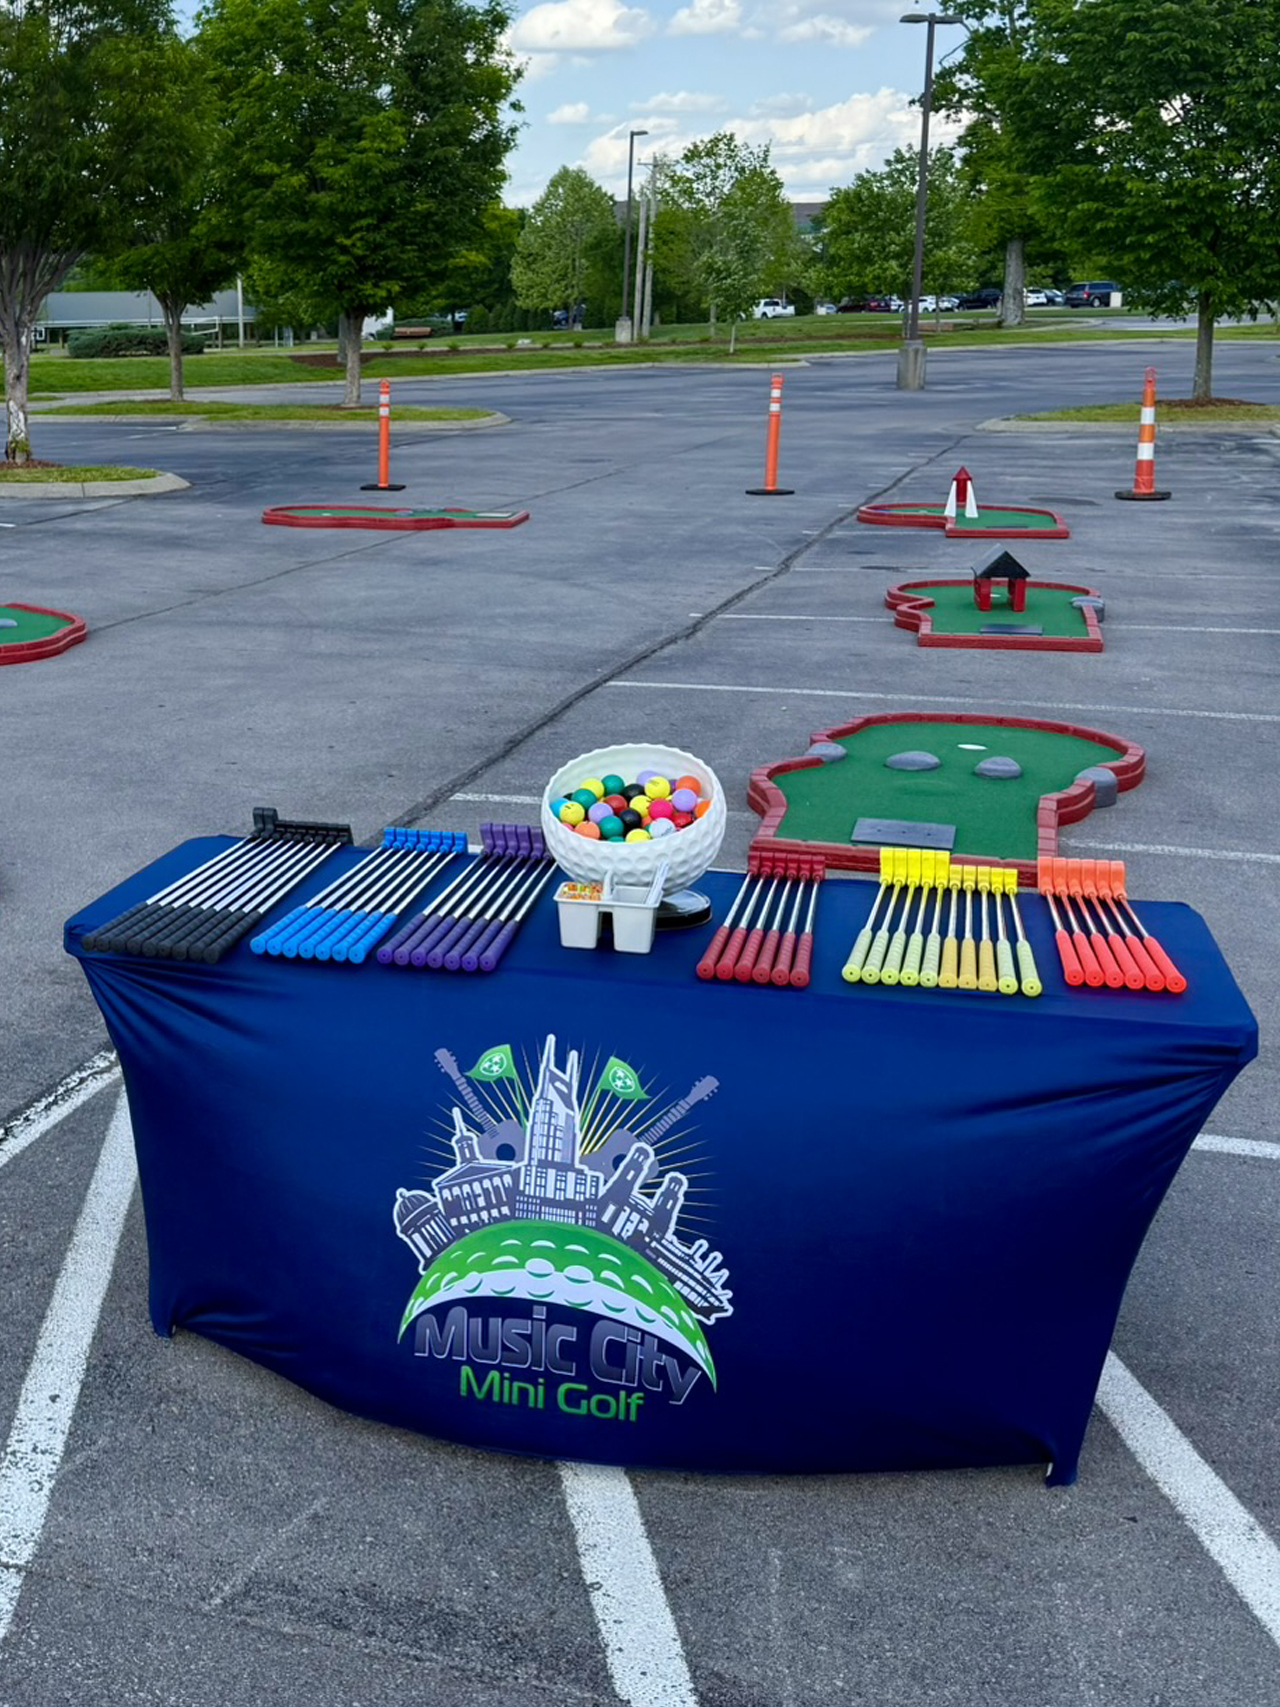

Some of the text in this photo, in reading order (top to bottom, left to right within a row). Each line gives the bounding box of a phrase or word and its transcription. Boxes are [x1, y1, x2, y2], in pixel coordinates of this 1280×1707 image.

[414, 1305, 701, 1405] Music City
[459, 1365, 644, 1422] Mini Golf
